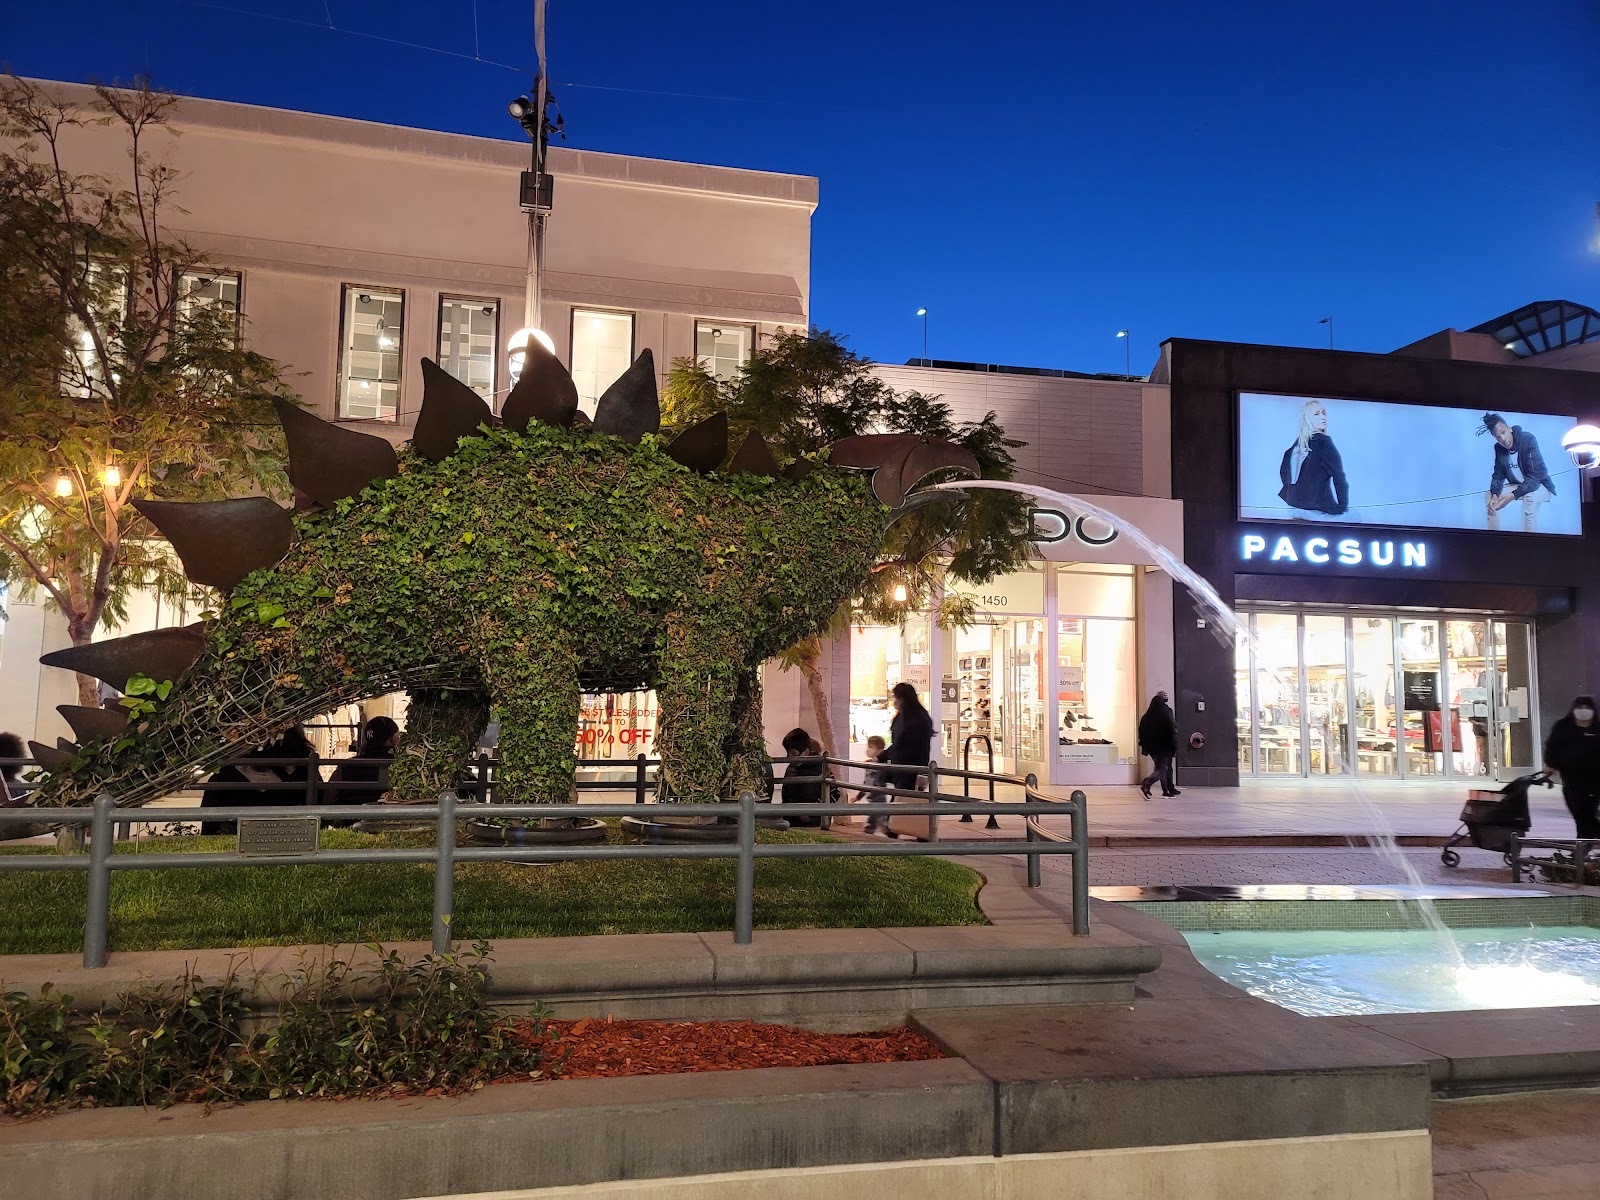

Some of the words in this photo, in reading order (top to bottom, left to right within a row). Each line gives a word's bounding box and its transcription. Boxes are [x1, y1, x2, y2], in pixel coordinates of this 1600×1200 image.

[1027, 507, 1120, 545] DO
[1242, 534, 1427, 567] PACSUN
[981, 595, 1008, 606] 1450
[615, 718, 626, 726] TO
[576, 729, 615, 744] 50%
[618, 729, 652, 744] OFF
